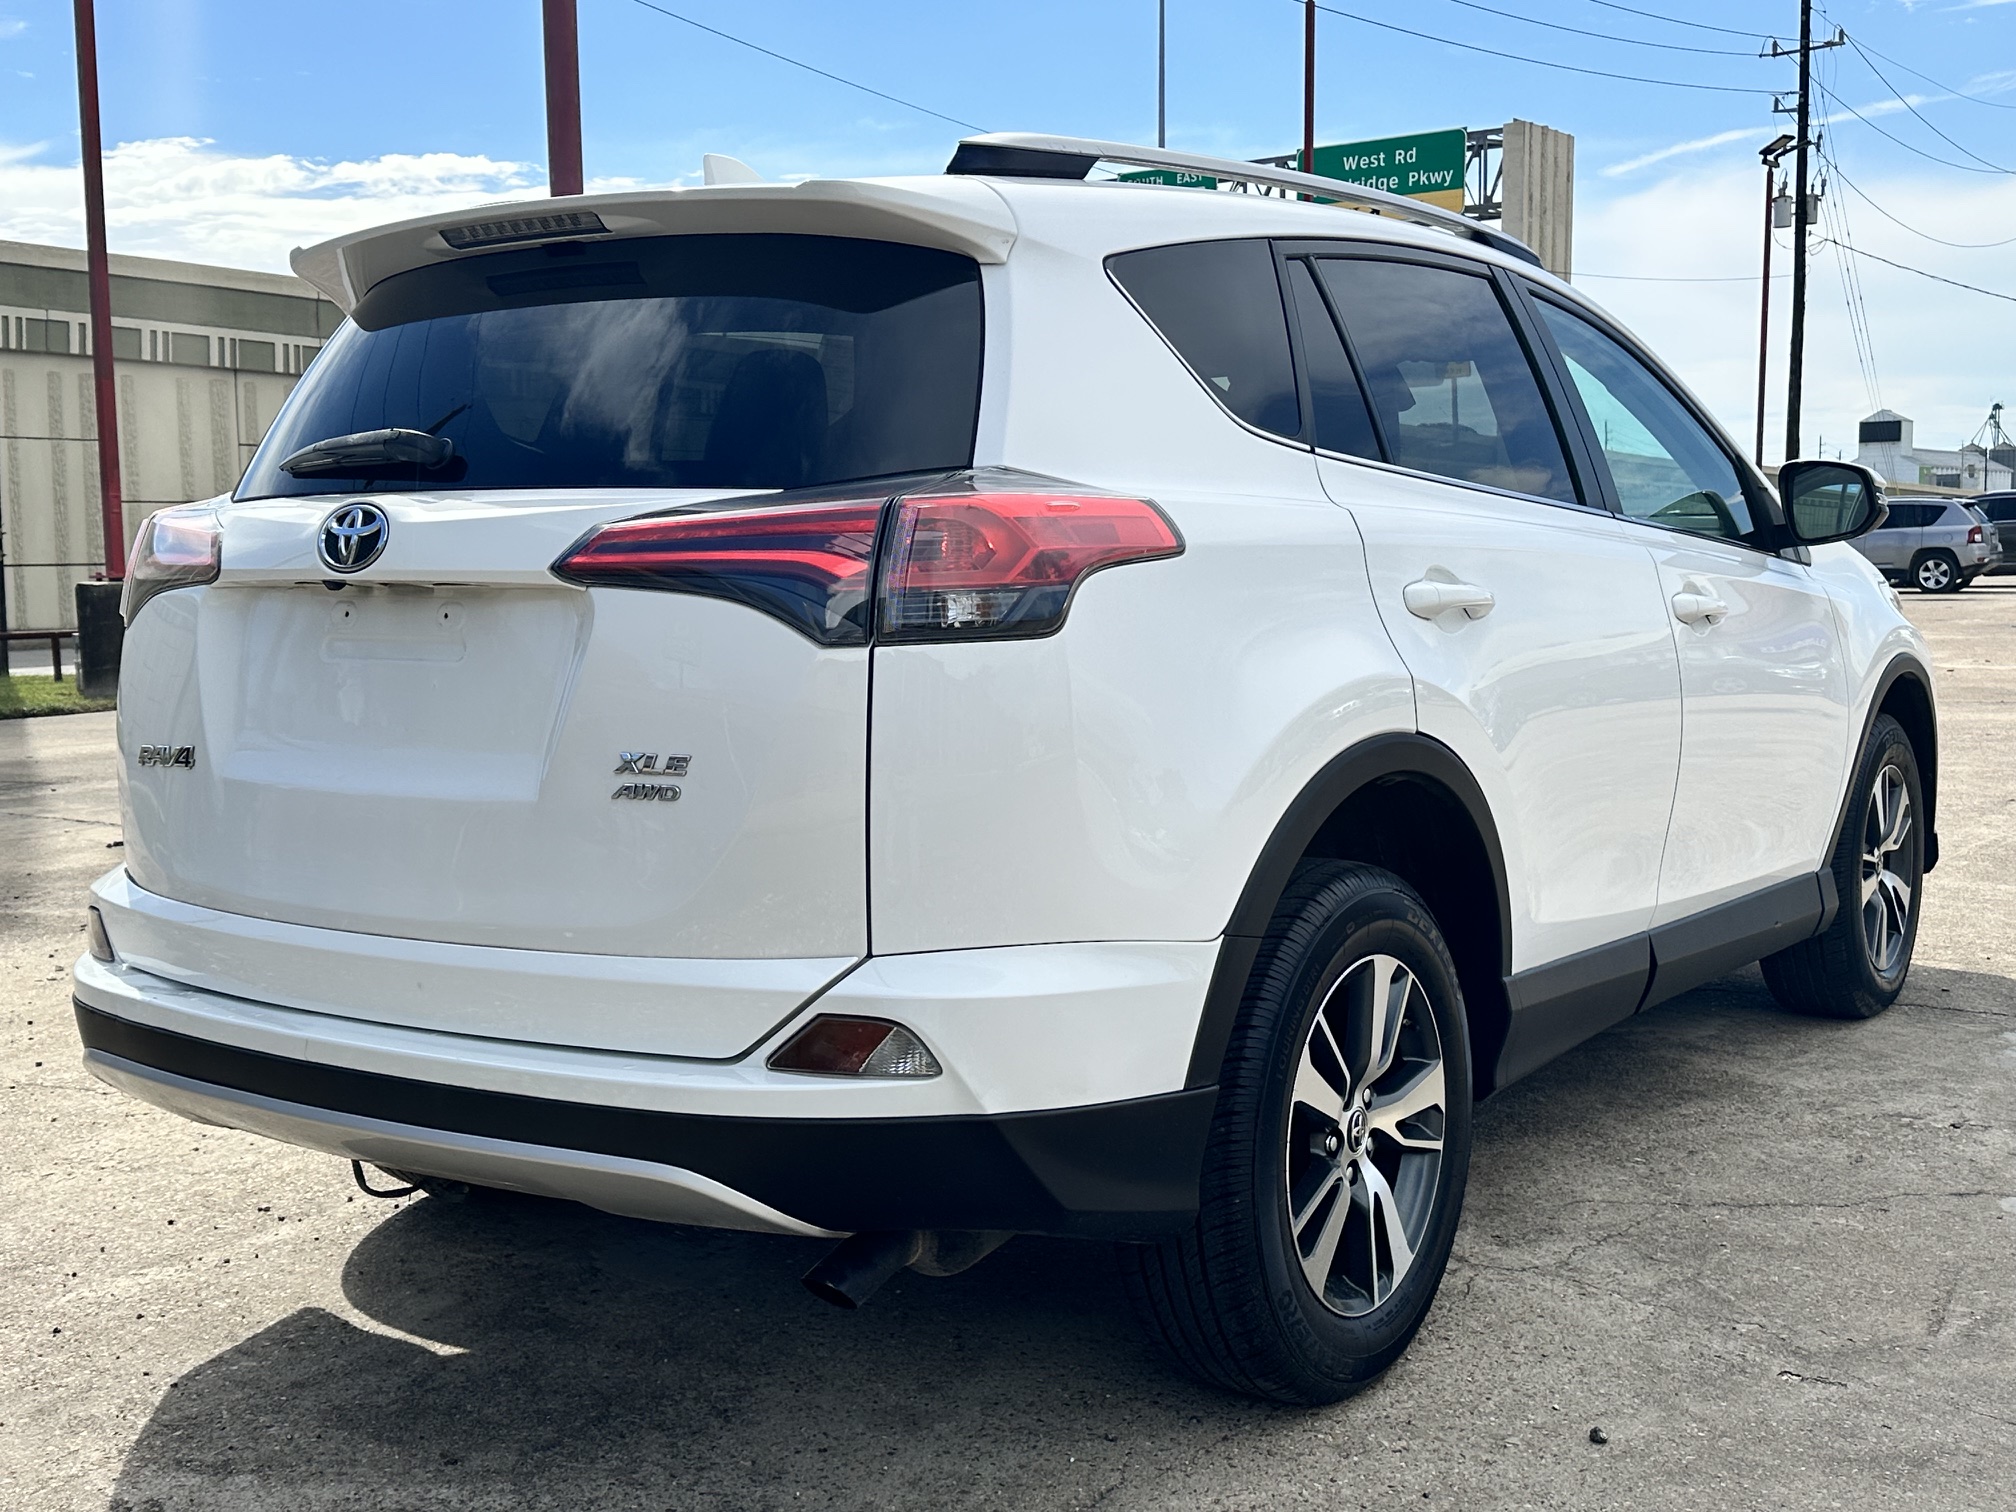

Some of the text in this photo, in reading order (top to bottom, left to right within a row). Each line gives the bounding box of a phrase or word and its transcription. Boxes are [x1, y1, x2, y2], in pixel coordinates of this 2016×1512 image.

[1343, 147, 1417, 171] West Rd
[1408, 169, 1454, 187] Pkwy
[138, 744, 196, 770] RAV4
[613, 751, 692, 777] XLE
[611, 782, 682, 801] AWD
